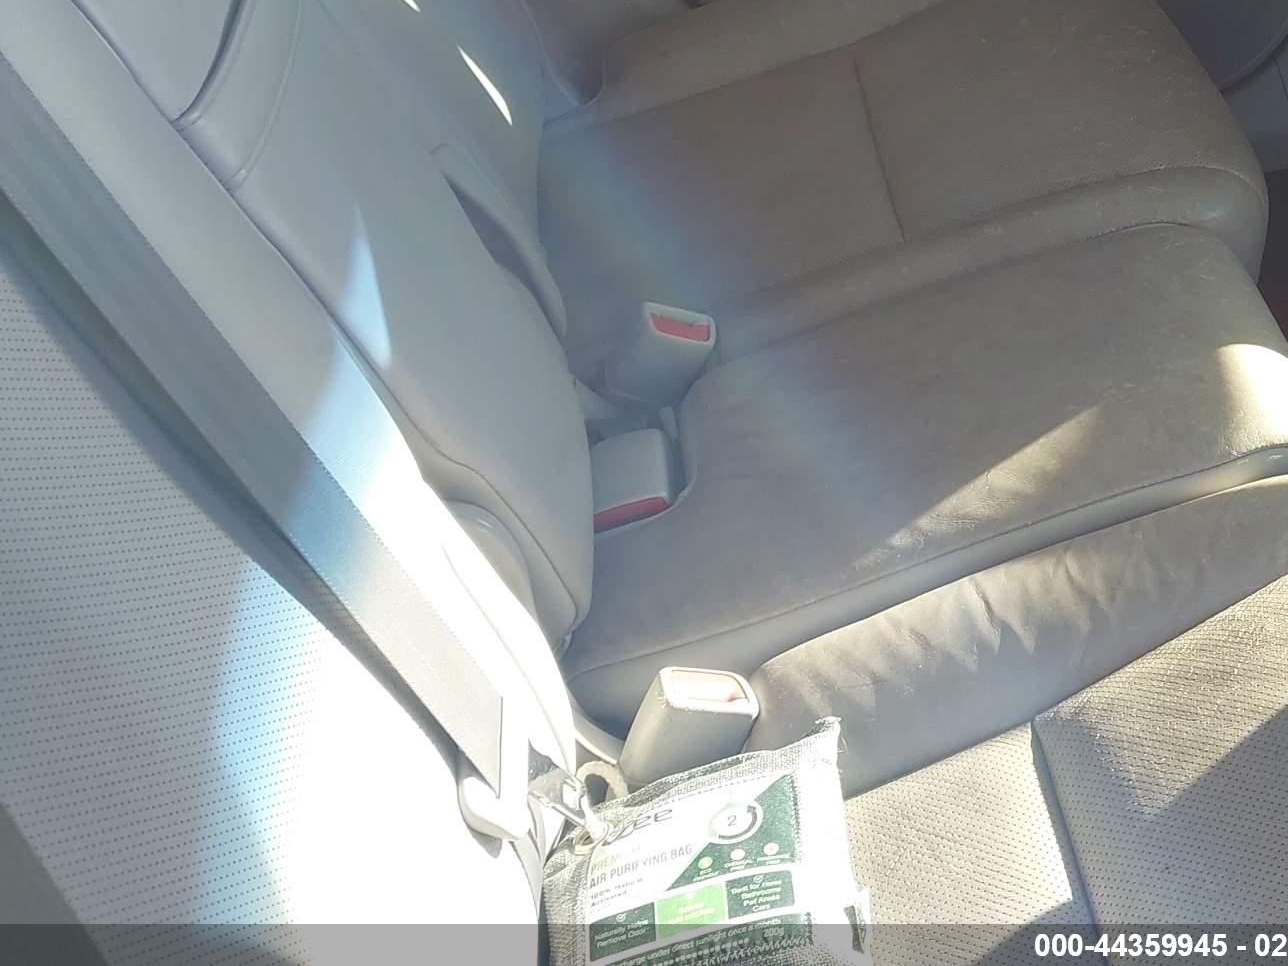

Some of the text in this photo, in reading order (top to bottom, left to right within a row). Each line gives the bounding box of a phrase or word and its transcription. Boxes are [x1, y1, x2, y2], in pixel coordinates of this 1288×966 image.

[727, 815, 737, 827] 2
[590, 844, 693, 889] AIR PURIFYING BAG
[742, 897, 758, 907] Pet
[647, 947, 671, 960] under
[671, 940, 695, 953] direct
[695, 930, 727, 947] sunlight
[728, 926, 747, 937] once
[754, 917, 782, 930] month
[763, 926, 785, 939] 200g
[596, 934, 627, 949] Remove
